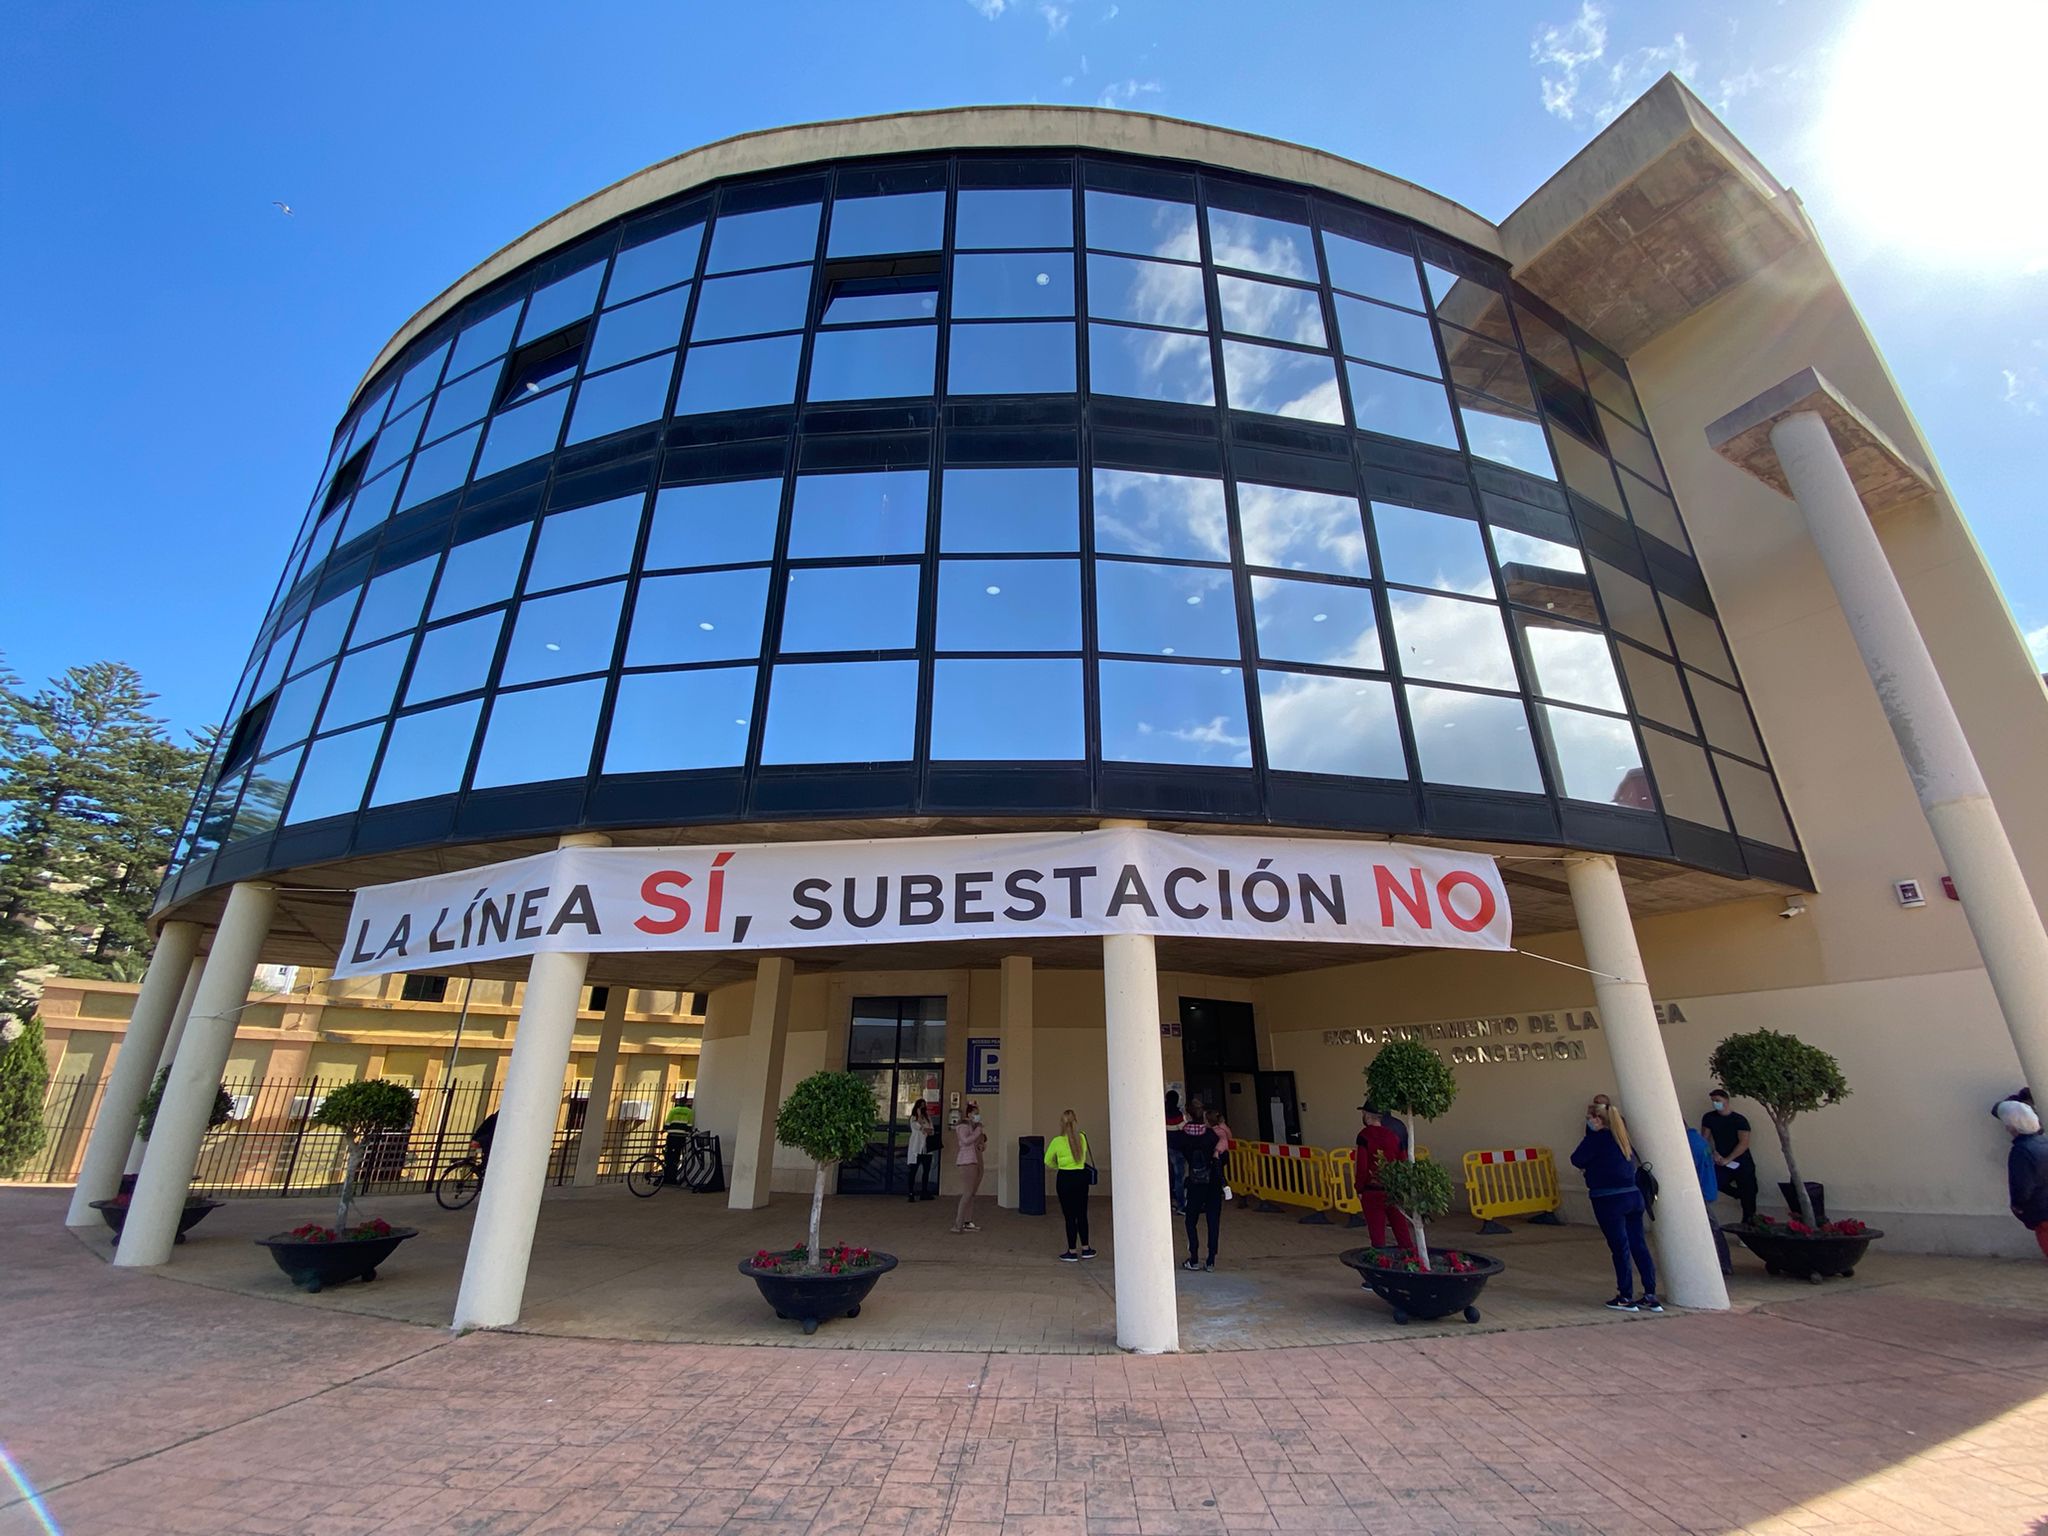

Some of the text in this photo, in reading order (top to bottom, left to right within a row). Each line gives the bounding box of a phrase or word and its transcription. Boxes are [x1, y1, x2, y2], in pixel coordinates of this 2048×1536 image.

[351, 851, 1496, 964] LA LÍNEA SÍ, SUBESTACIÓN NO
[1529, 1014, 1559, 1034] DE
[1566, 1011, 1600, 1031] LA
[980, 1048, 1000, 1083] P
[1452, 1035, 1588, 1064] CONCEPCIÓN
